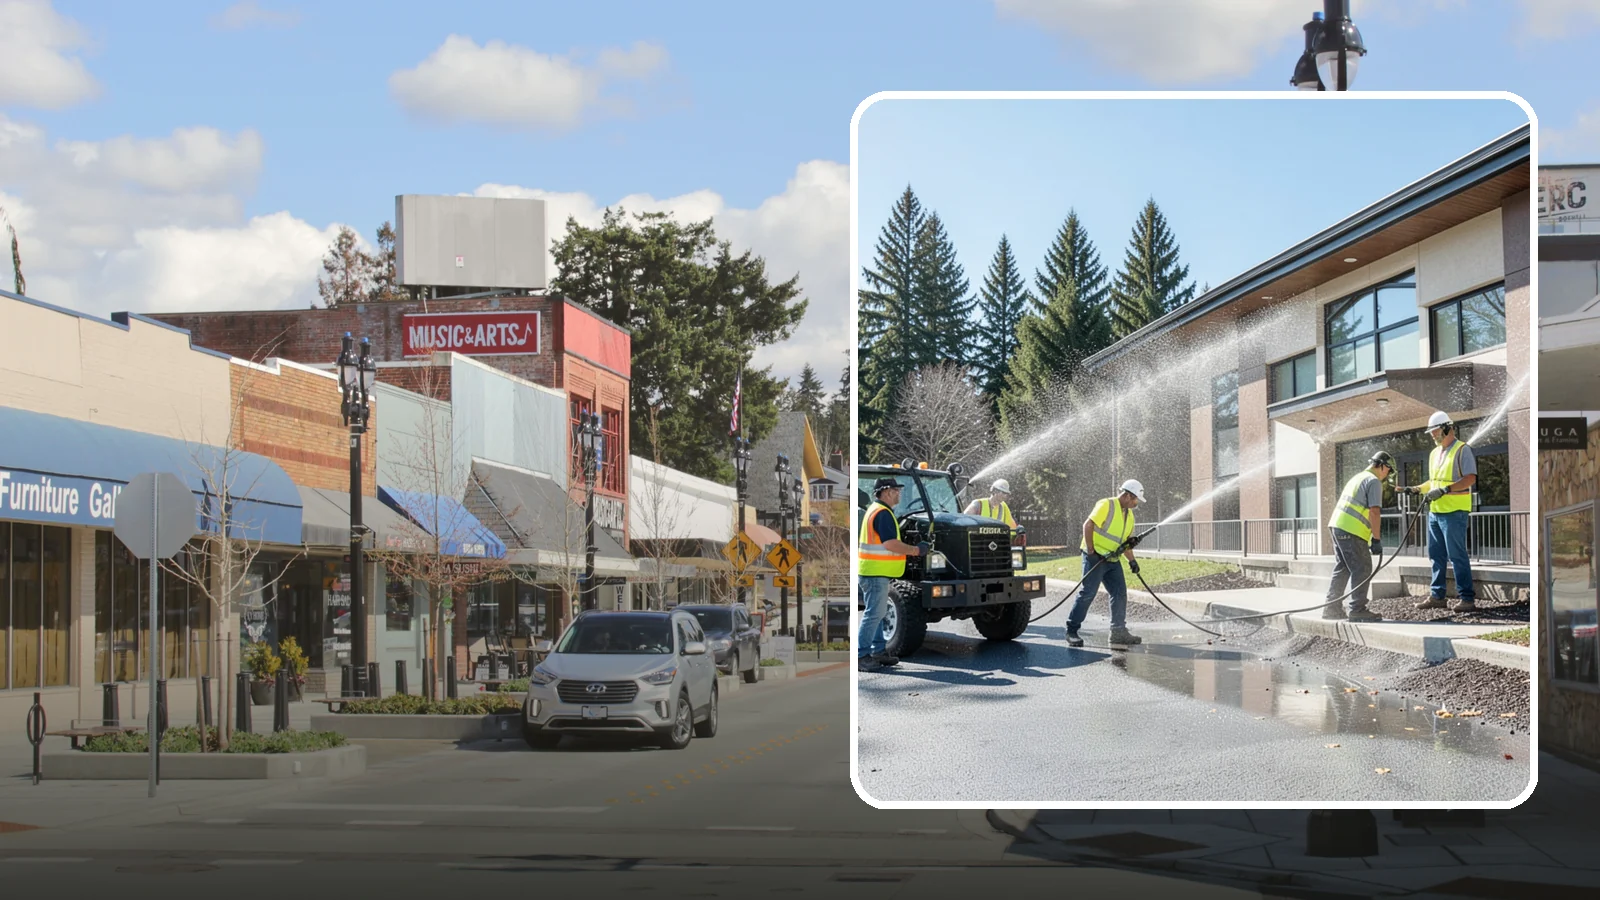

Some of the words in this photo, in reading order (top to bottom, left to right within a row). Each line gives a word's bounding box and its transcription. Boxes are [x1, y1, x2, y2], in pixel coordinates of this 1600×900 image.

[0, 471, 79, 515] Furniture
[89, 482, 121, 519] Gal
[453, 563, 479, 574] SUSHI
